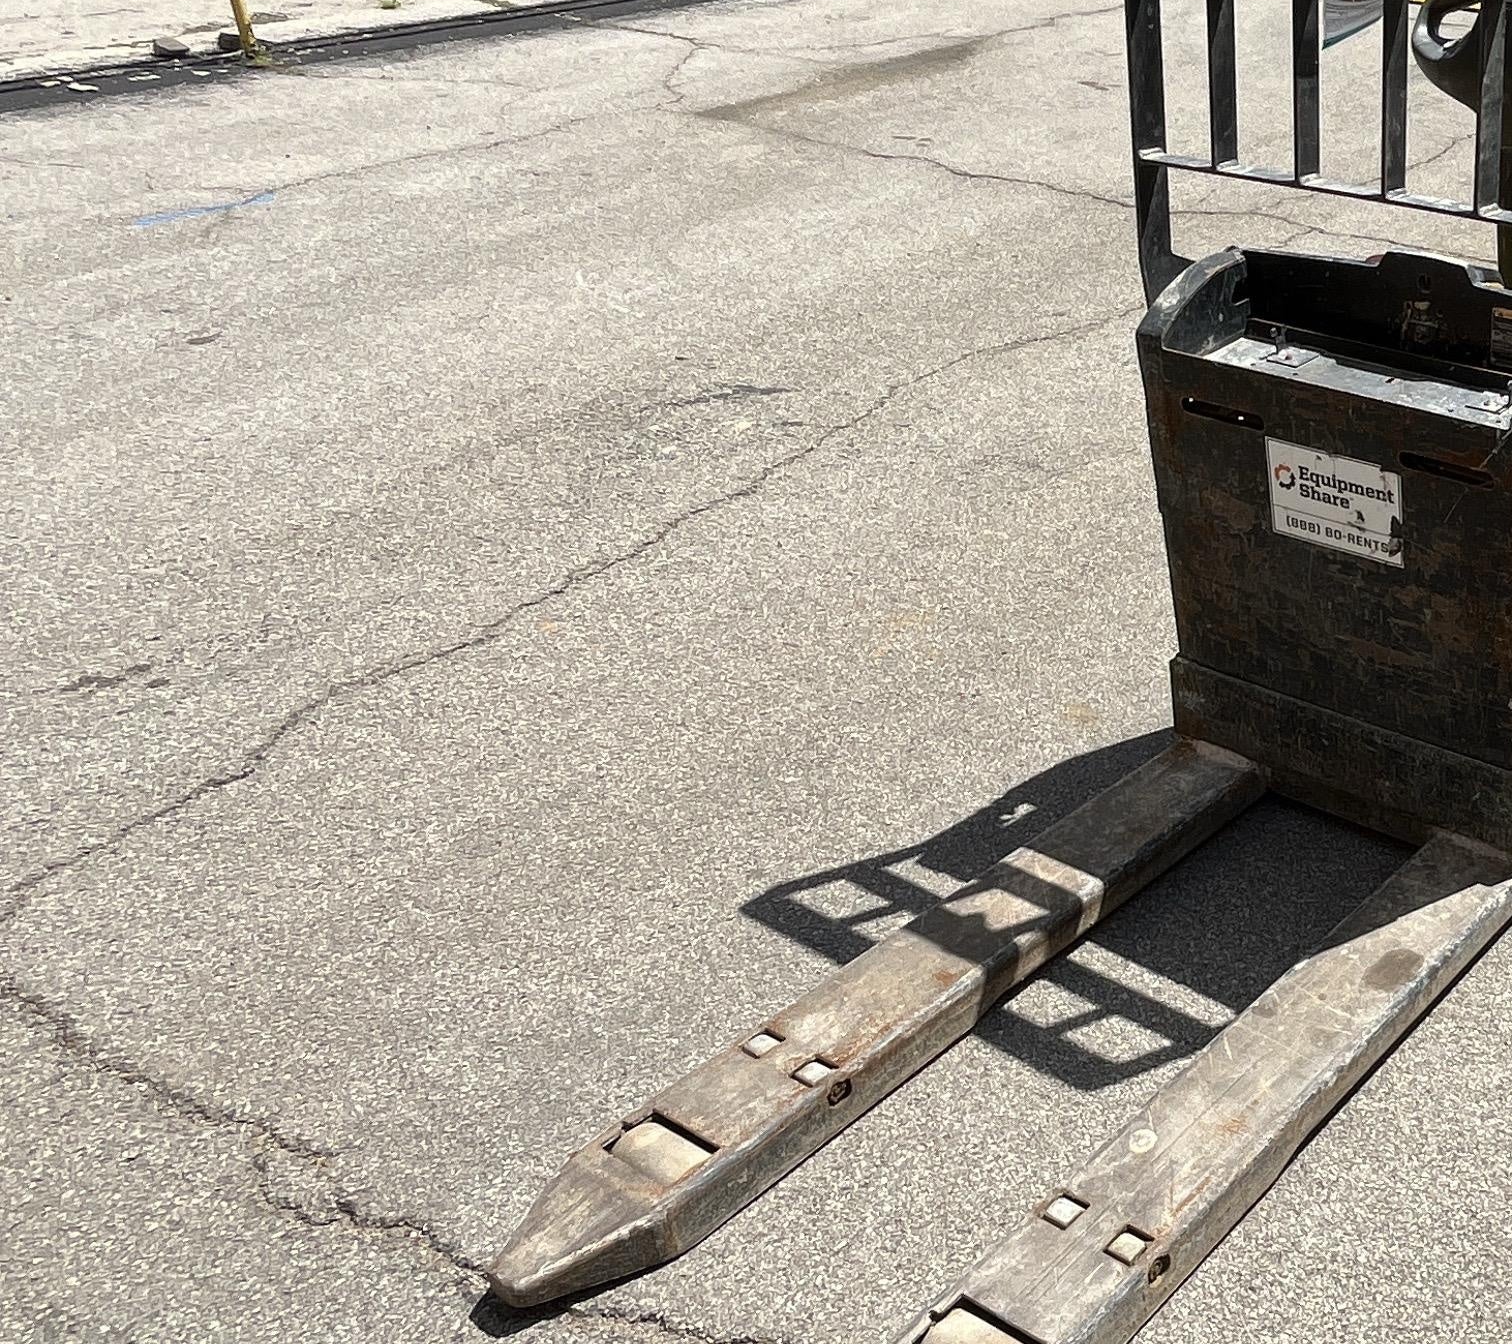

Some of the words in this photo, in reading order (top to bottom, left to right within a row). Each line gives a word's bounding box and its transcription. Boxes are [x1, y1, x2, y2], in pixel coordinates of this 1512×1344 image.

[1298, 465, 1395, 504] Equipment
[1299, 483, 1350, 509] Share
[1286, 515, 1321, 535] (888)
